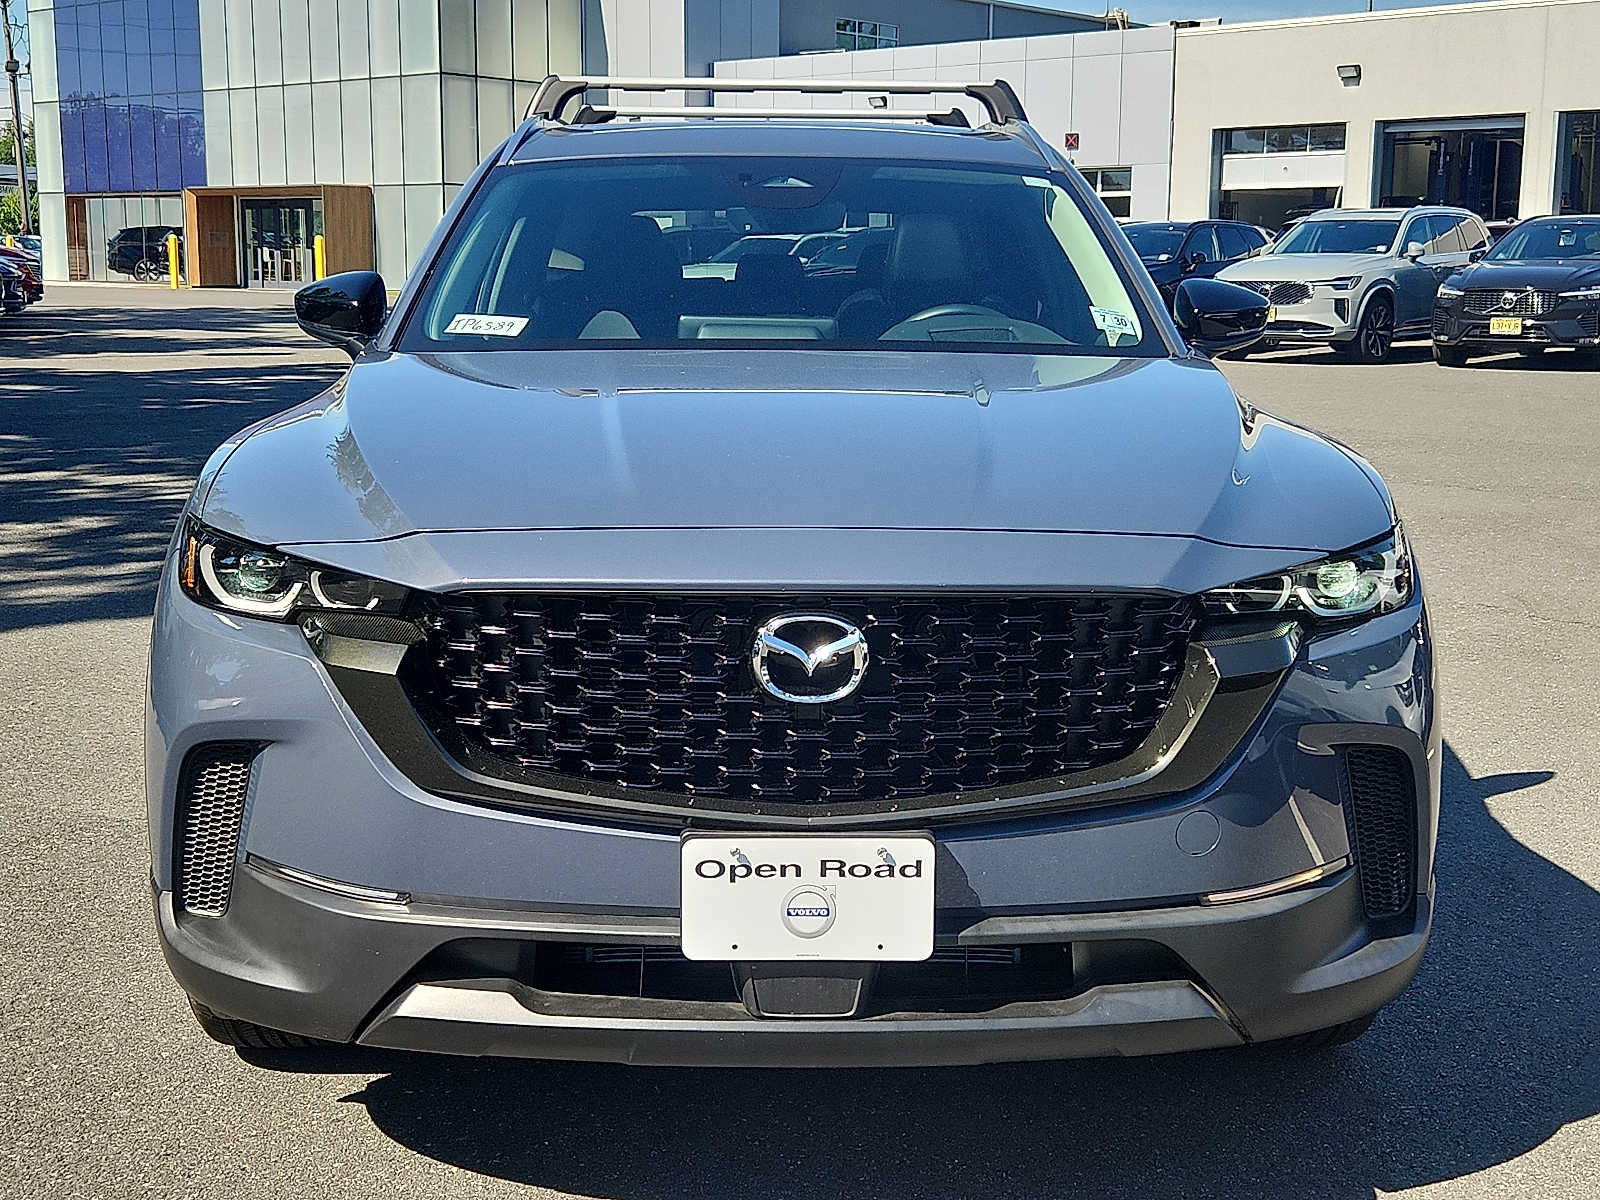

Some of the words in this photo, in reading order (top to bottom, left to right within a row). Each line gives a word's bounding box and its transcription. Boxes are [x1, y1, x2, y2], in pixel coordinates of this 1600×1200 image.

[1100, 314, 1106, 323] 7
[1114, 316, 1128, 327] 30
[695, 860, 802, 883] Open
[820, 859, 922, 878] Road
[788, 908, 829, 916] VOLVO
